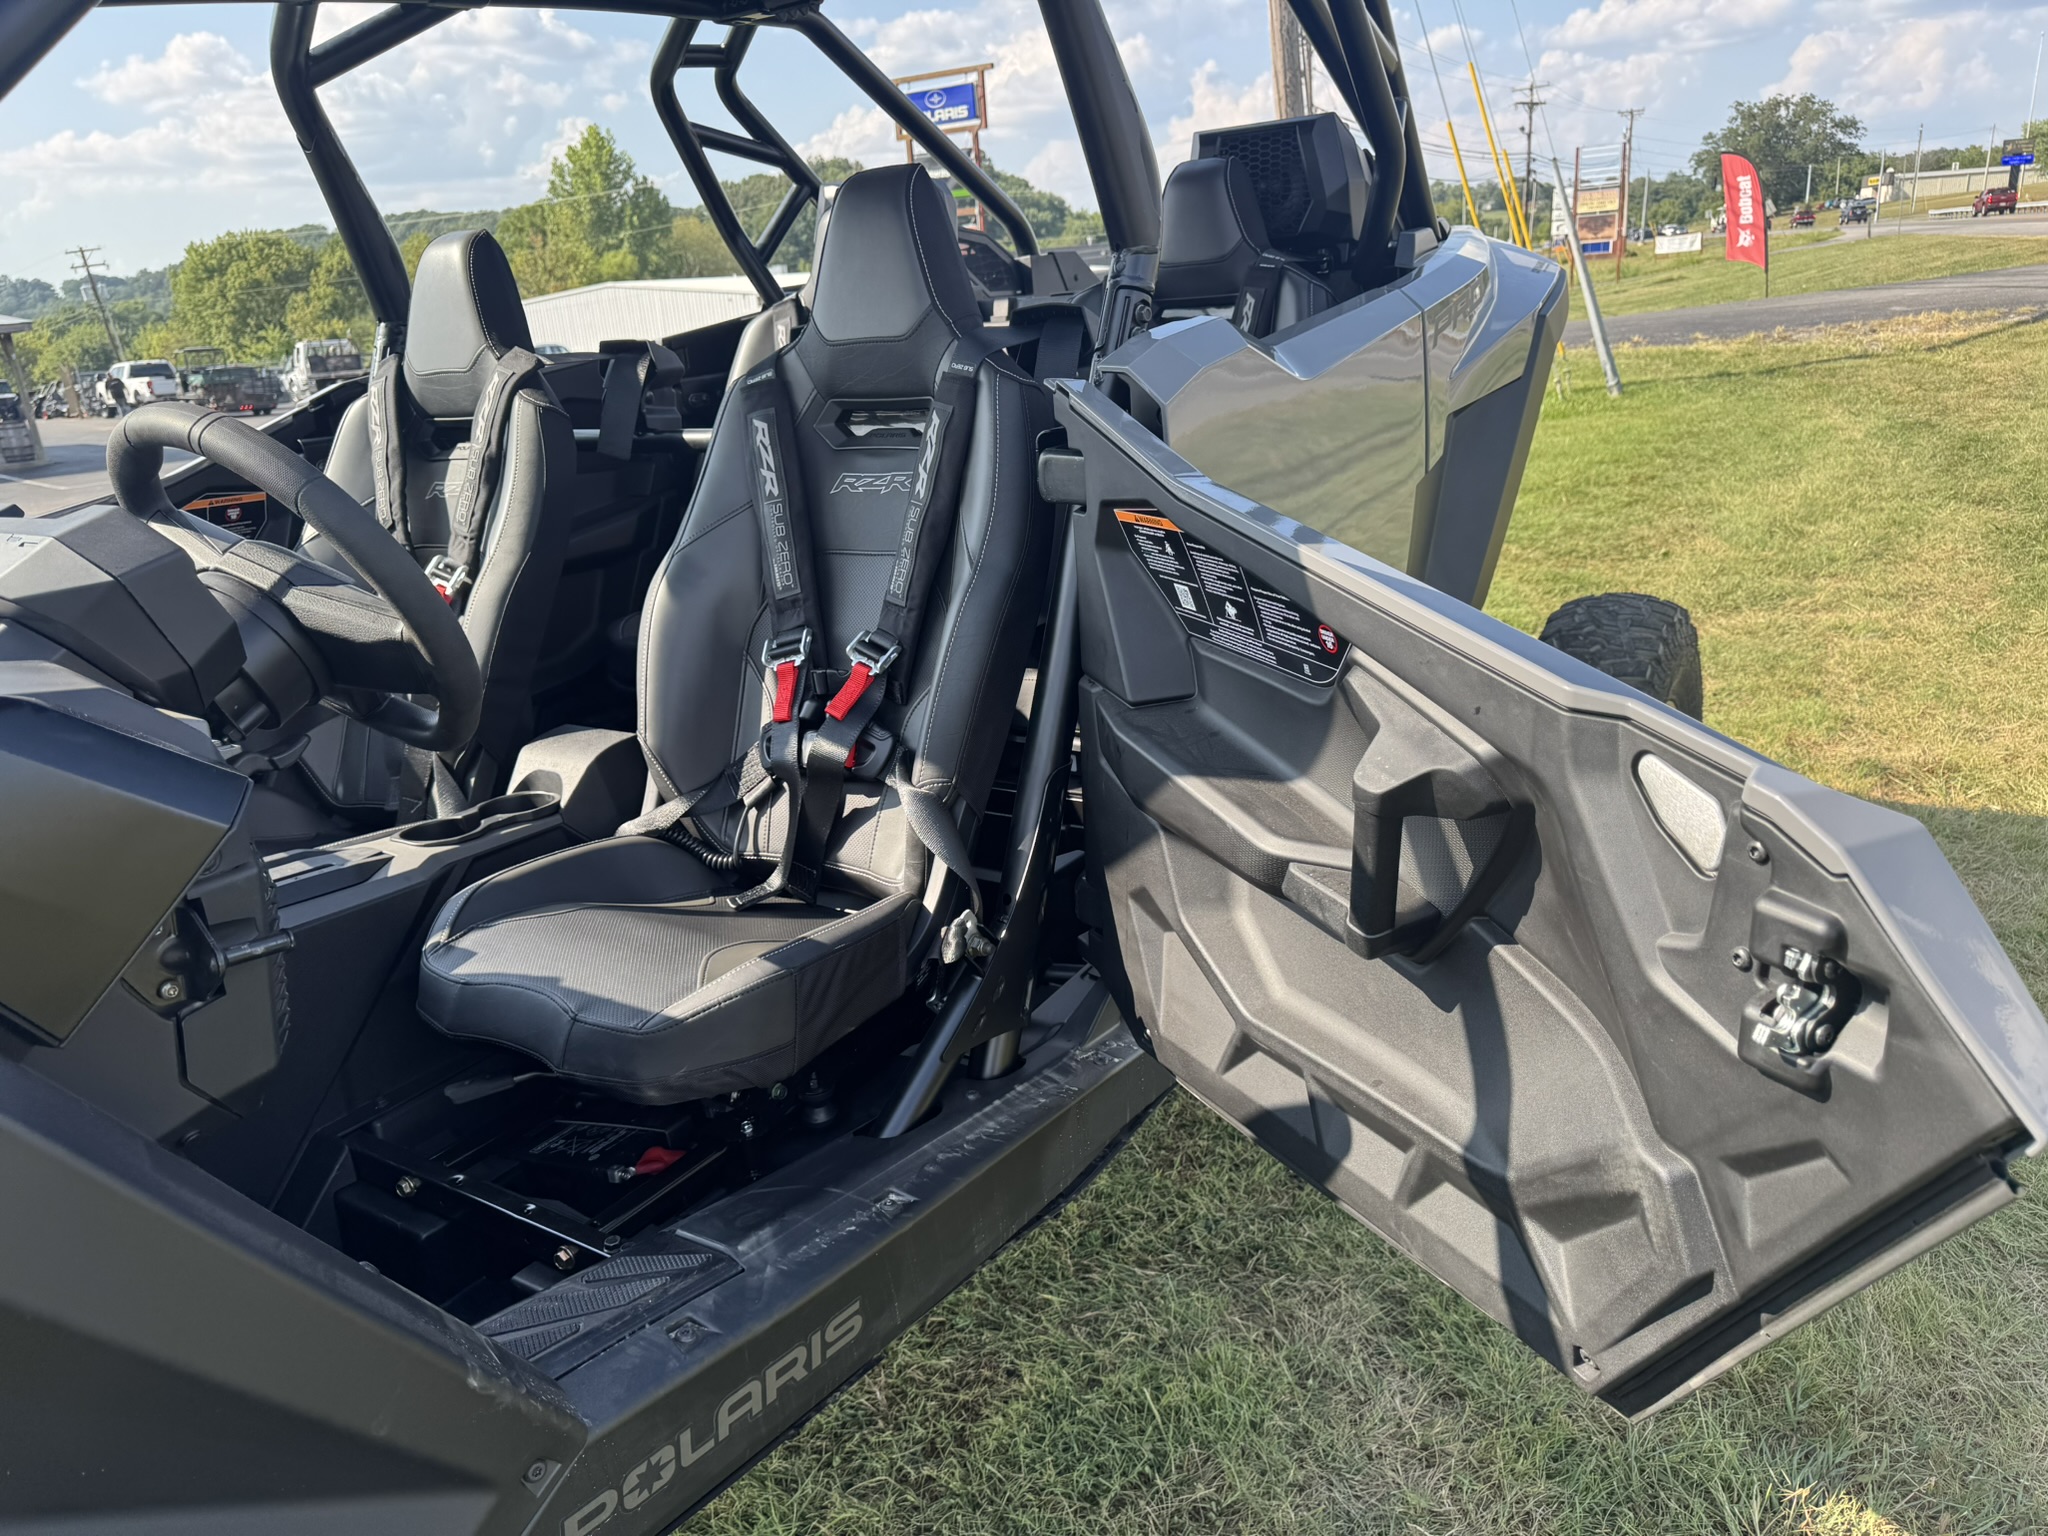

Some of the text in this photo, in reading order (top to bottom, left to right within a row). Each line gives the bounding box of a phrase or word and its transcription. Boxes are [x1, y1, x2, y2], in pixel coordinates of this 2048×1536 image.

[923, 105, 969, 122] LARIS
[1736, 174, 1754, 225] Bobcat
[1240, 292, 1255, 332] RZ
[370, 385, 382, 445] RZR
[475, 372, 500, 443] RZR
[752, 418, 779, 497] RZR
[914, 409, 940, 500] RZR
[374, 451, 387, 519] SUB ZERO
[425, 482, 464, 499] RZ
[457, 450, 480, 522] SUB ZERO
[830, 472, 914, 494] RZR
[772, 503, 786, 537] SUB
[904, 506, 921, 543] SUB
[778, 541, 794, 586] ZERO
[895, 546, 911, 594] ZERO
[562, 1299, 863, 1536] POLARIS
